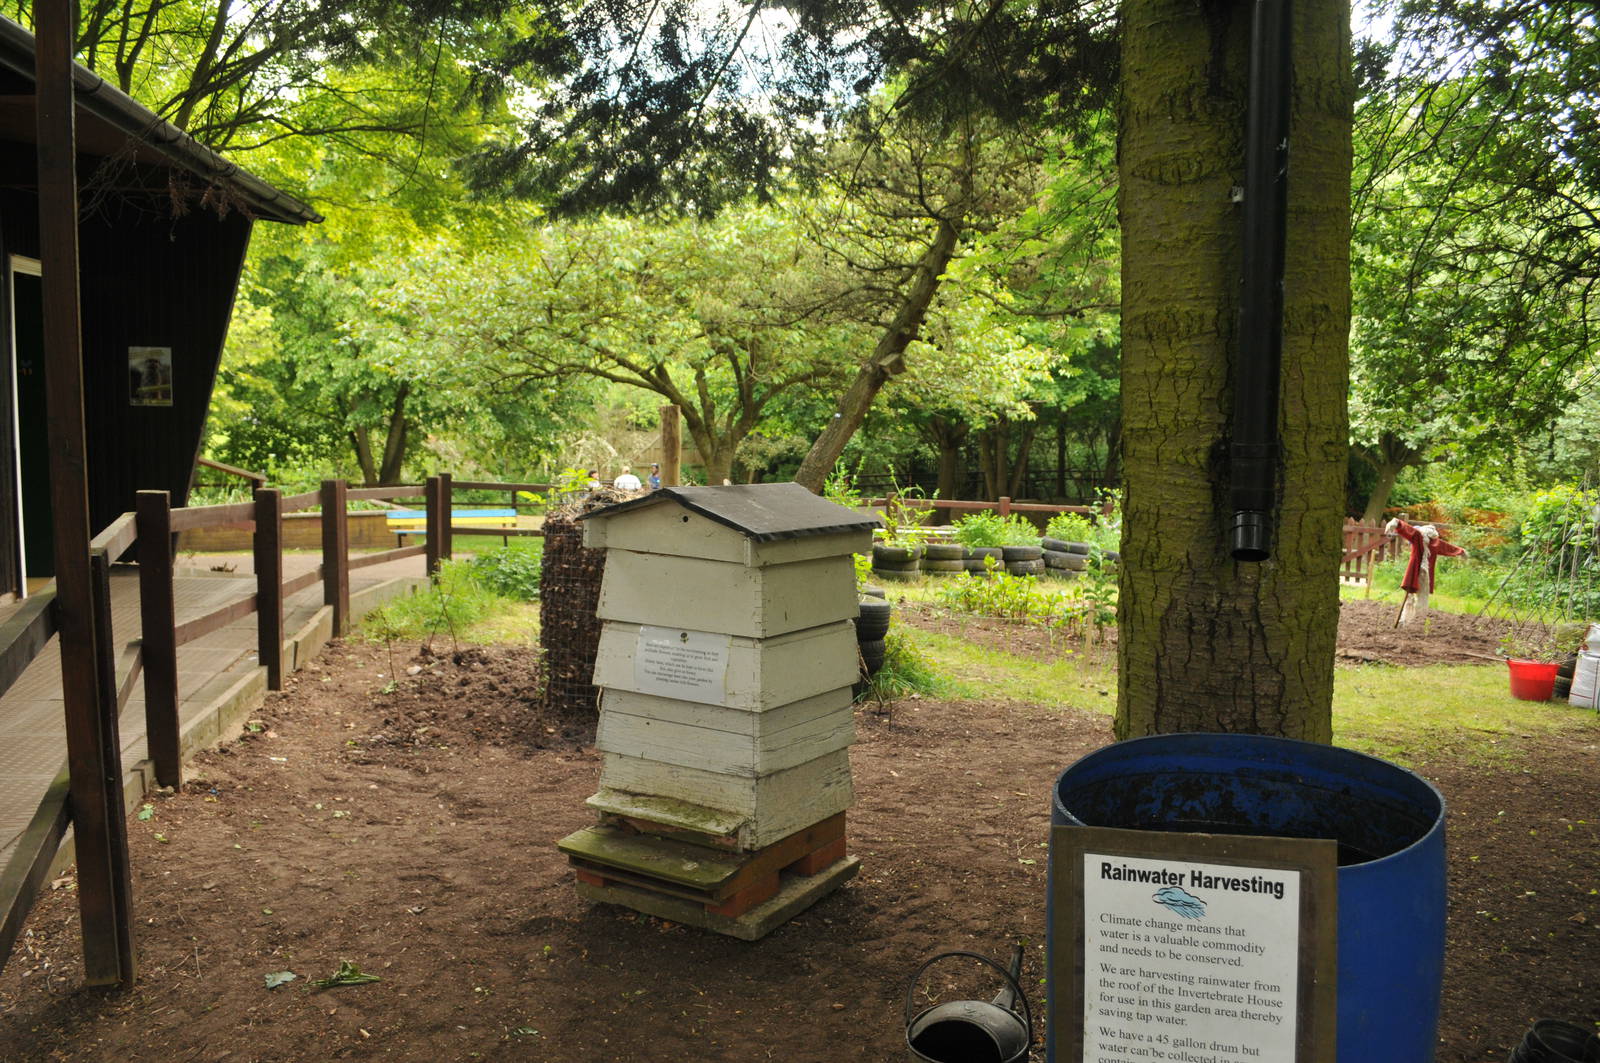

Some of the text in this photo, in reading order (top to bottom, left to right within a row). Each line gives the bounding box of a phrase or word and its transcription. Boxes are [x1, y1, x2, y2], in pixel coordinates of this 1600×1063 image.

[1101, 861, 1284, 900] Rainwater Harvesting
[1100, 913, 1245, 937] Climate change means that
[1100, 930, 1129, 940] water
[1132, 930, 1141, 941] is
[1154, 934, 1199, 947] valuable
[1202, 941, 1265, 956] commodity
[1100, 942, 1243, 967] and needs to be conserved.
[1100, 963, 1280, 992] We are harvesting rainwater from
[1099, 977, 1283, 1008] the roof of the Invertebrate House
[1099, 1008, 1187, 1026] saving tap water.
[1100, 992, 1282, 1025] for use in this garden area thereby
[1099, 1026, 1259, 1056] We have a 45 gallon drum but
[1099, 1043, 1128, 1054] water
[1130, 1048, 1149, 1056] can
[1151, 1047, 1165, 1058] be
[1168, 1051, 1216, 1063] collected
